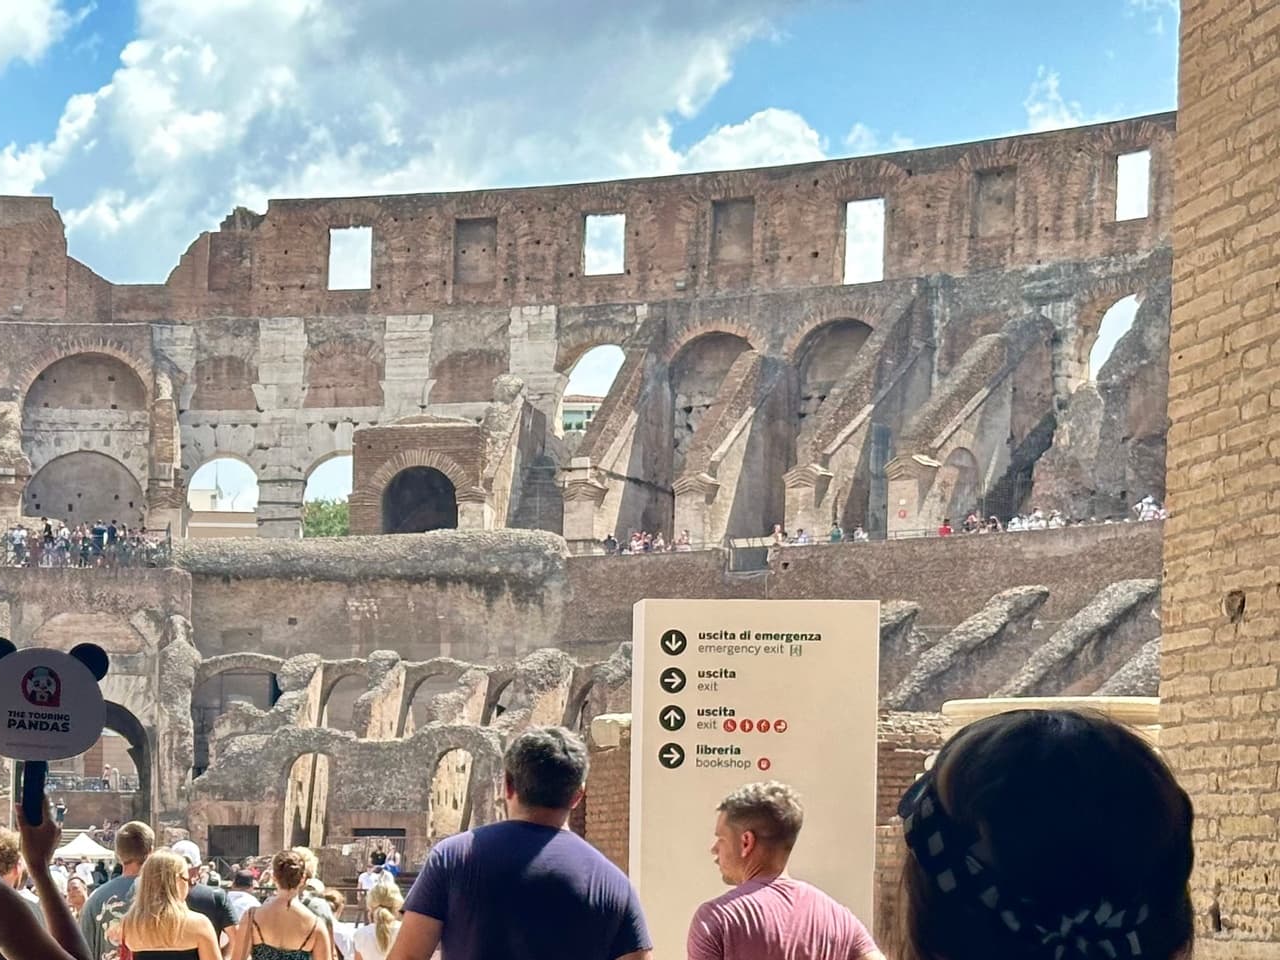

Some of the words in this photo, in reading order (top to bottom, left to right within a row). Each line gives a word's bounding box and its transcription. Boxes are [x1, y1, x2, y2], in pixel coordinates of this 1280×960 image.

[698, 630, 736, 641] uscita
[739, 630, 751, 641] di
[754, 631, 822, 643] emergenza
[697, 645, 761, 656] emergency
[763, 643, 785, 654] exit
[697, 668, 737, 679] uscita
[697, 681, 719, 692] exit
[7, 710, 26, 719] THE
[28, 711, 71, 721] TOURING
[696, 706, 736, 717] uscita
[7, 718, 71, 733] PANDAS
[696, 719, 718, 730] exit
[696, 744, 741, 755] libreria
[695, 758, 752, 769] bookshop
